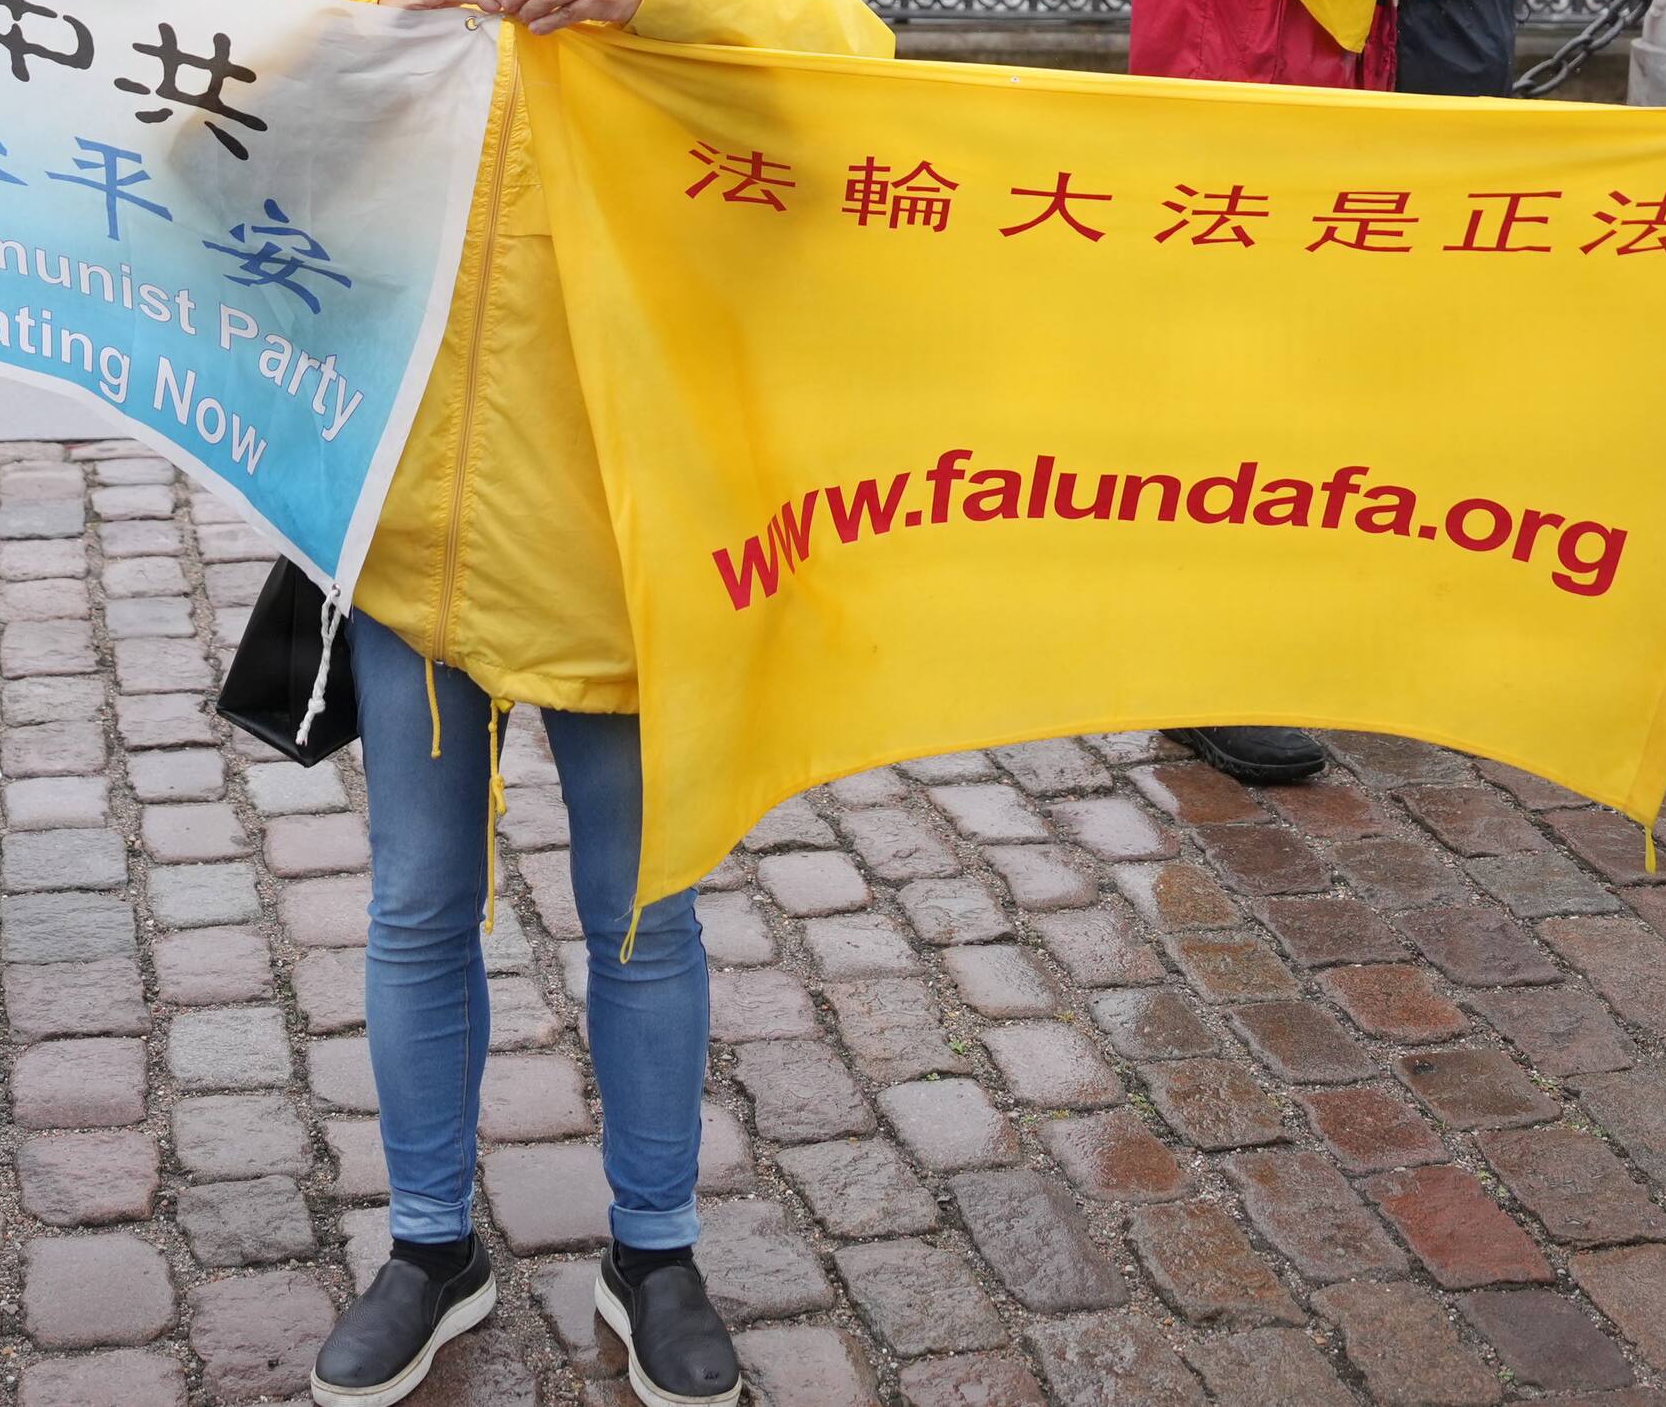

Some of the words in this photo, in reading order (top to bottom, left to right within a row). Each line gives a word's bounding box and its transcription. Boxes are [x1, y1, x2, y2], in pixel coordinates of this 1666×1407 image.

[152, 354, 269, 476] Now
[218, 301, 365, 442] Party
[711, 448, 1630, 613] www.falundafa.org
